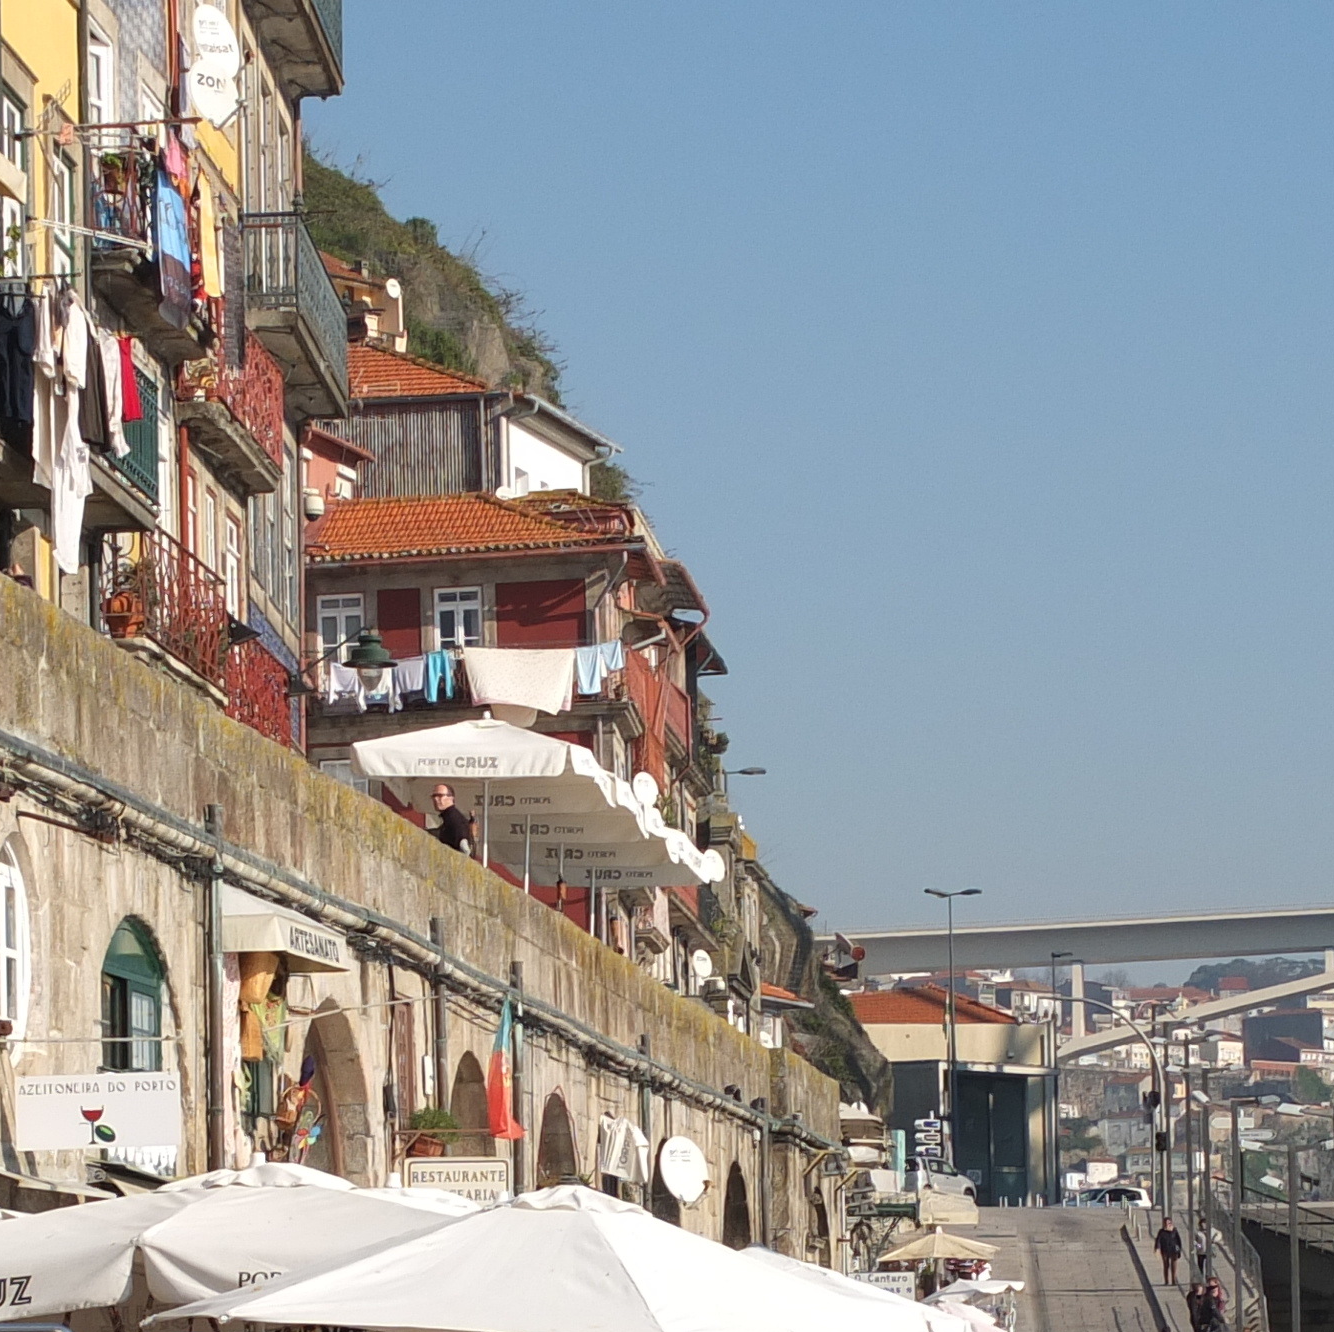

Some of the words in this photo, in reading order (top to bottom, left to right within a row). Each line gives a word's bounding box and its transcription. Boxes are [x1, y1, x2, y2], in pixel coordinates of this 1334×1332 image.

[454, 755, 499, 769] CRUZ
[18, 1082, 100, 1096] AZEITONEIRA
[107, 1081, 126, 1092] DO
[134, 1079, 176, 1092] PORTO
[412, 1170, 505, 1183] RESTAURANTE
